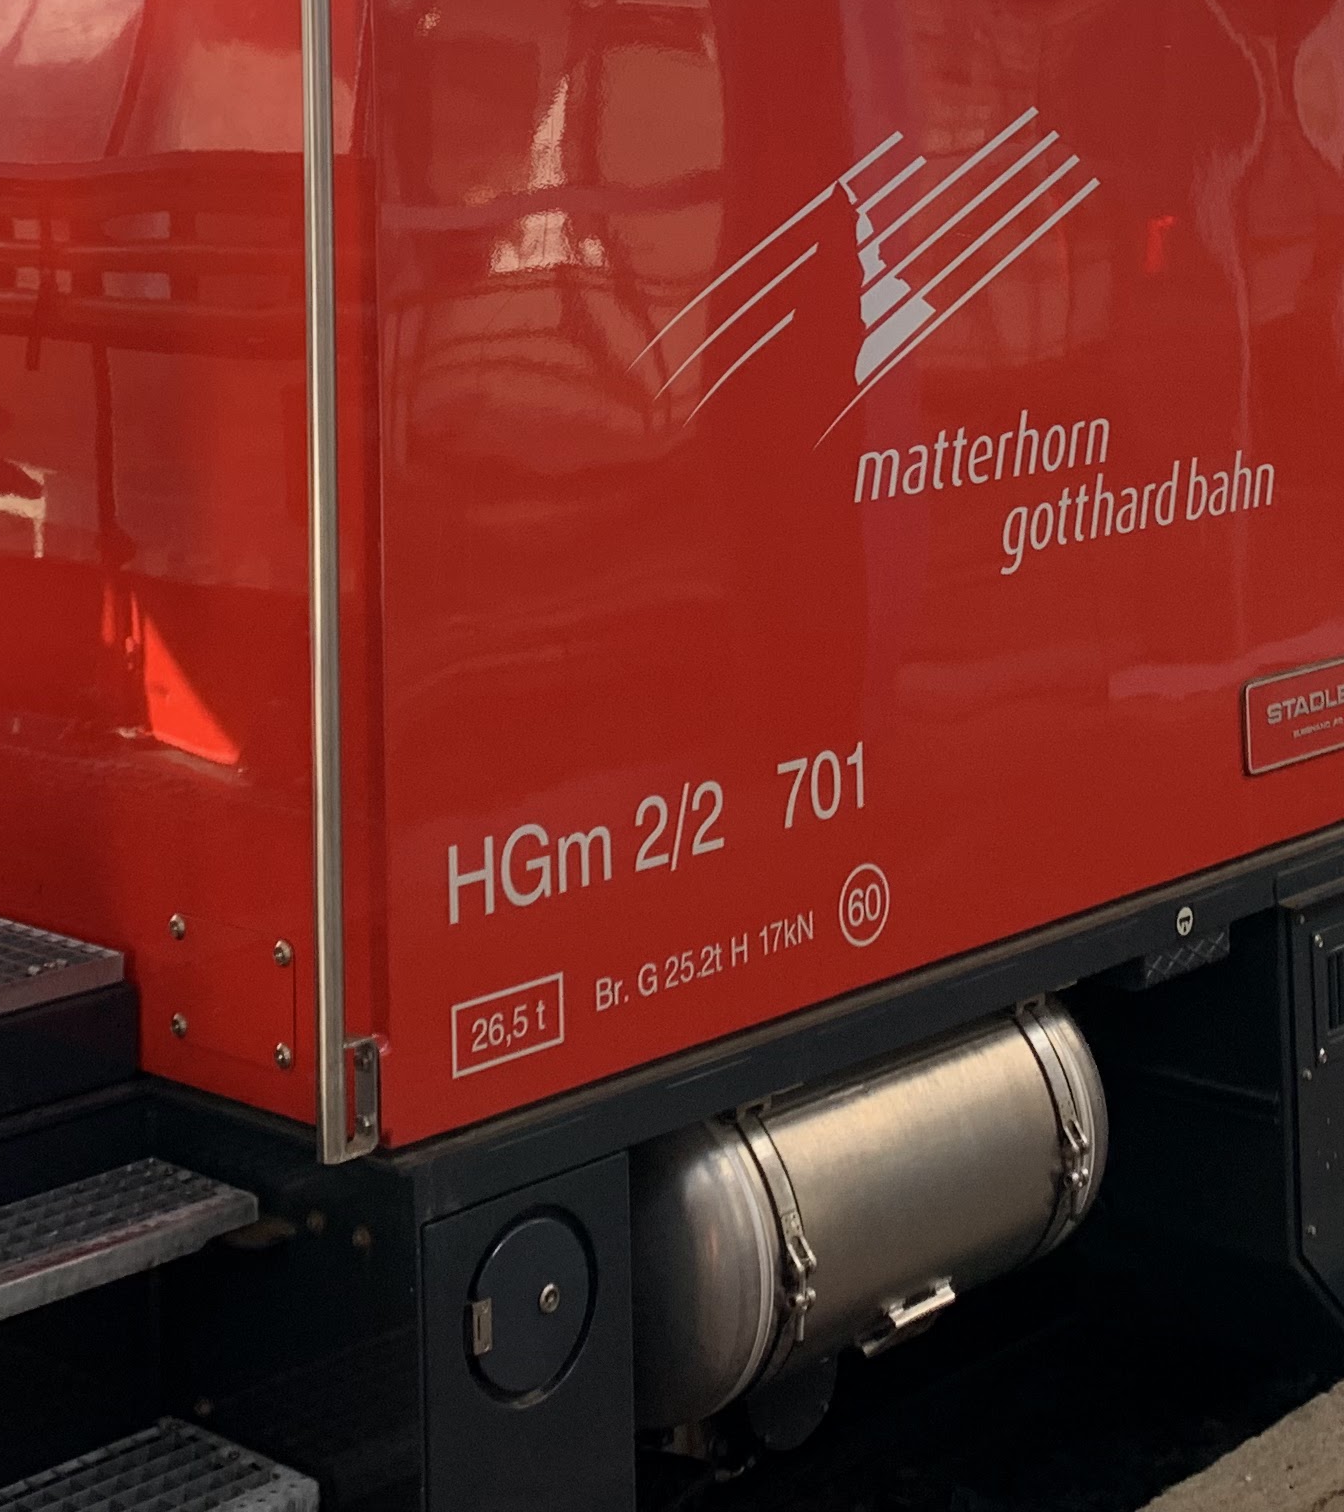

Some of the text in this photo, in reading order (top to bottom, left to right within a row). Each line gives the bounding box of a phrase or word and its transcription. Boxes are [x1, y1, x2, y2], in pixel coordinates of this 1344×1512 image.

[854, 409, 1110, 503] matterhorn
[446, 740, 866, 925] HGm 2/2 701
[847, 882, 881, 927] 60
[595, 910, 814, 1012] Br. G 25.2t H 17kN
[470, 999, 546, 1052] 26,5 t
